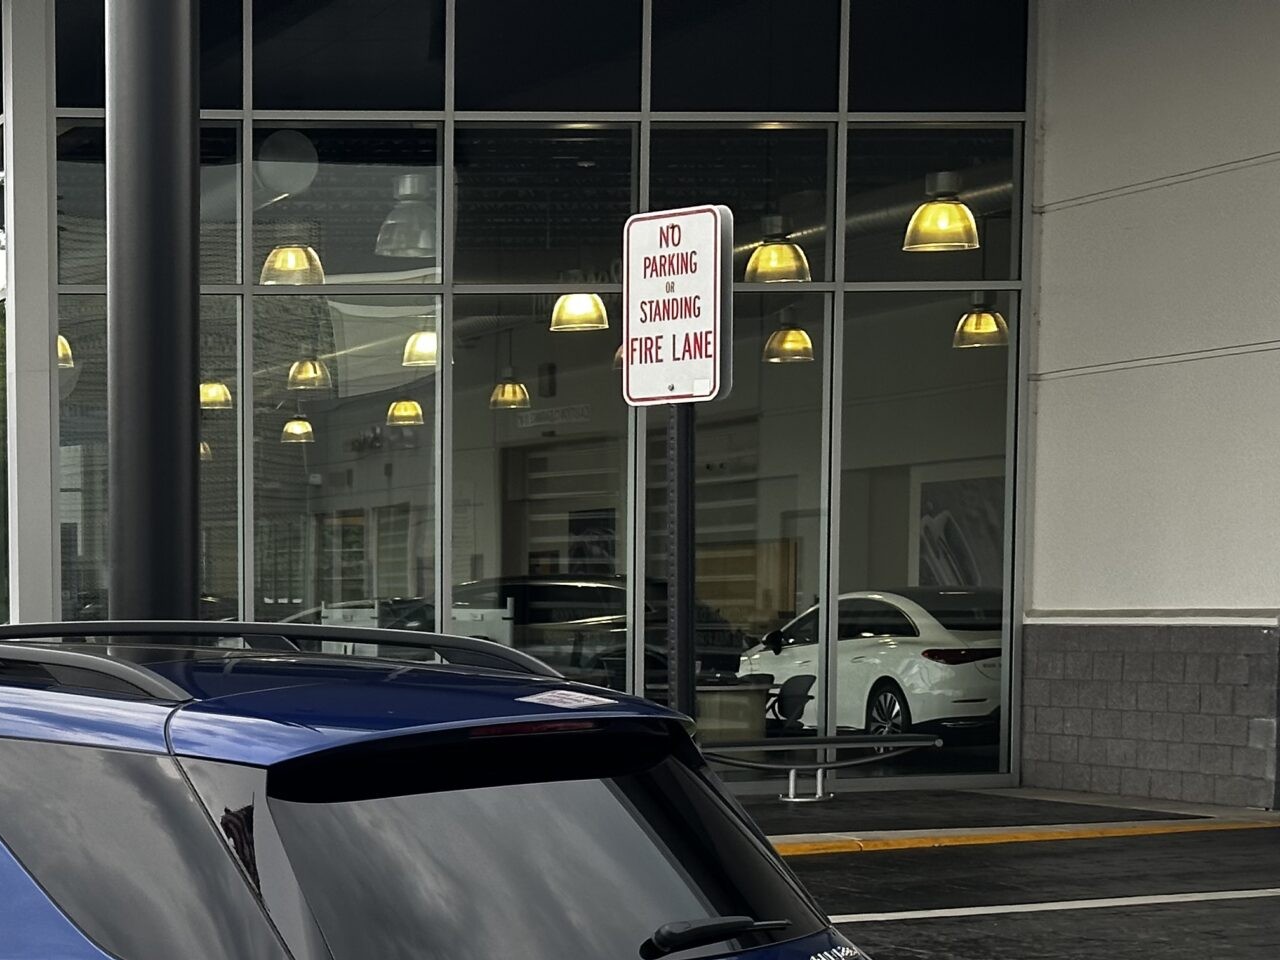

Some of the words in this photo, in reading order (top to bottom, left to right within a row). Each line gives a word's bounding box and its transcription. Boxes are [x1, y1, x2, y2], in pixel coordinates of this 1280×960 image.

[659, 224, 681, 248] NO
[643, 250, 698, 279] PARKING
[665, 282, 675, 294] OR
[639, 295, 701, 324] STANDING
[630, 335, 663, 365] FIRE
[672, 331, 713, 361] LANE
